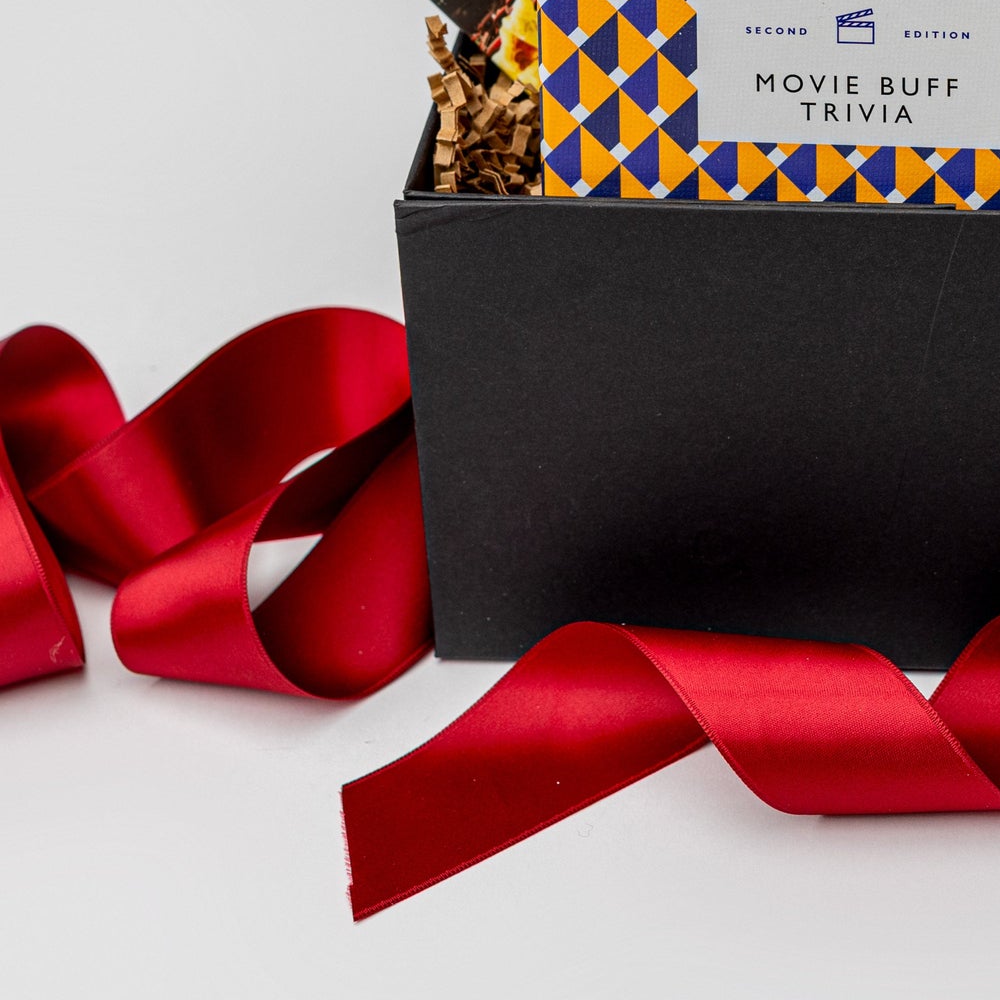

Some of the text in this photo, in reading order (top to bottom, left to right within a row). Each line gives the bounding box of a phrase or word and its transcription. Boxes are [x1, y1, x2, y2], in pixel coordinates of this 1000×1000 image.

[745, 26, 971, 40] SECOND EDITION
[756, 73, 959, 97] MOVIE BUFF
[800, 102, 913, 124] TRIVIA
